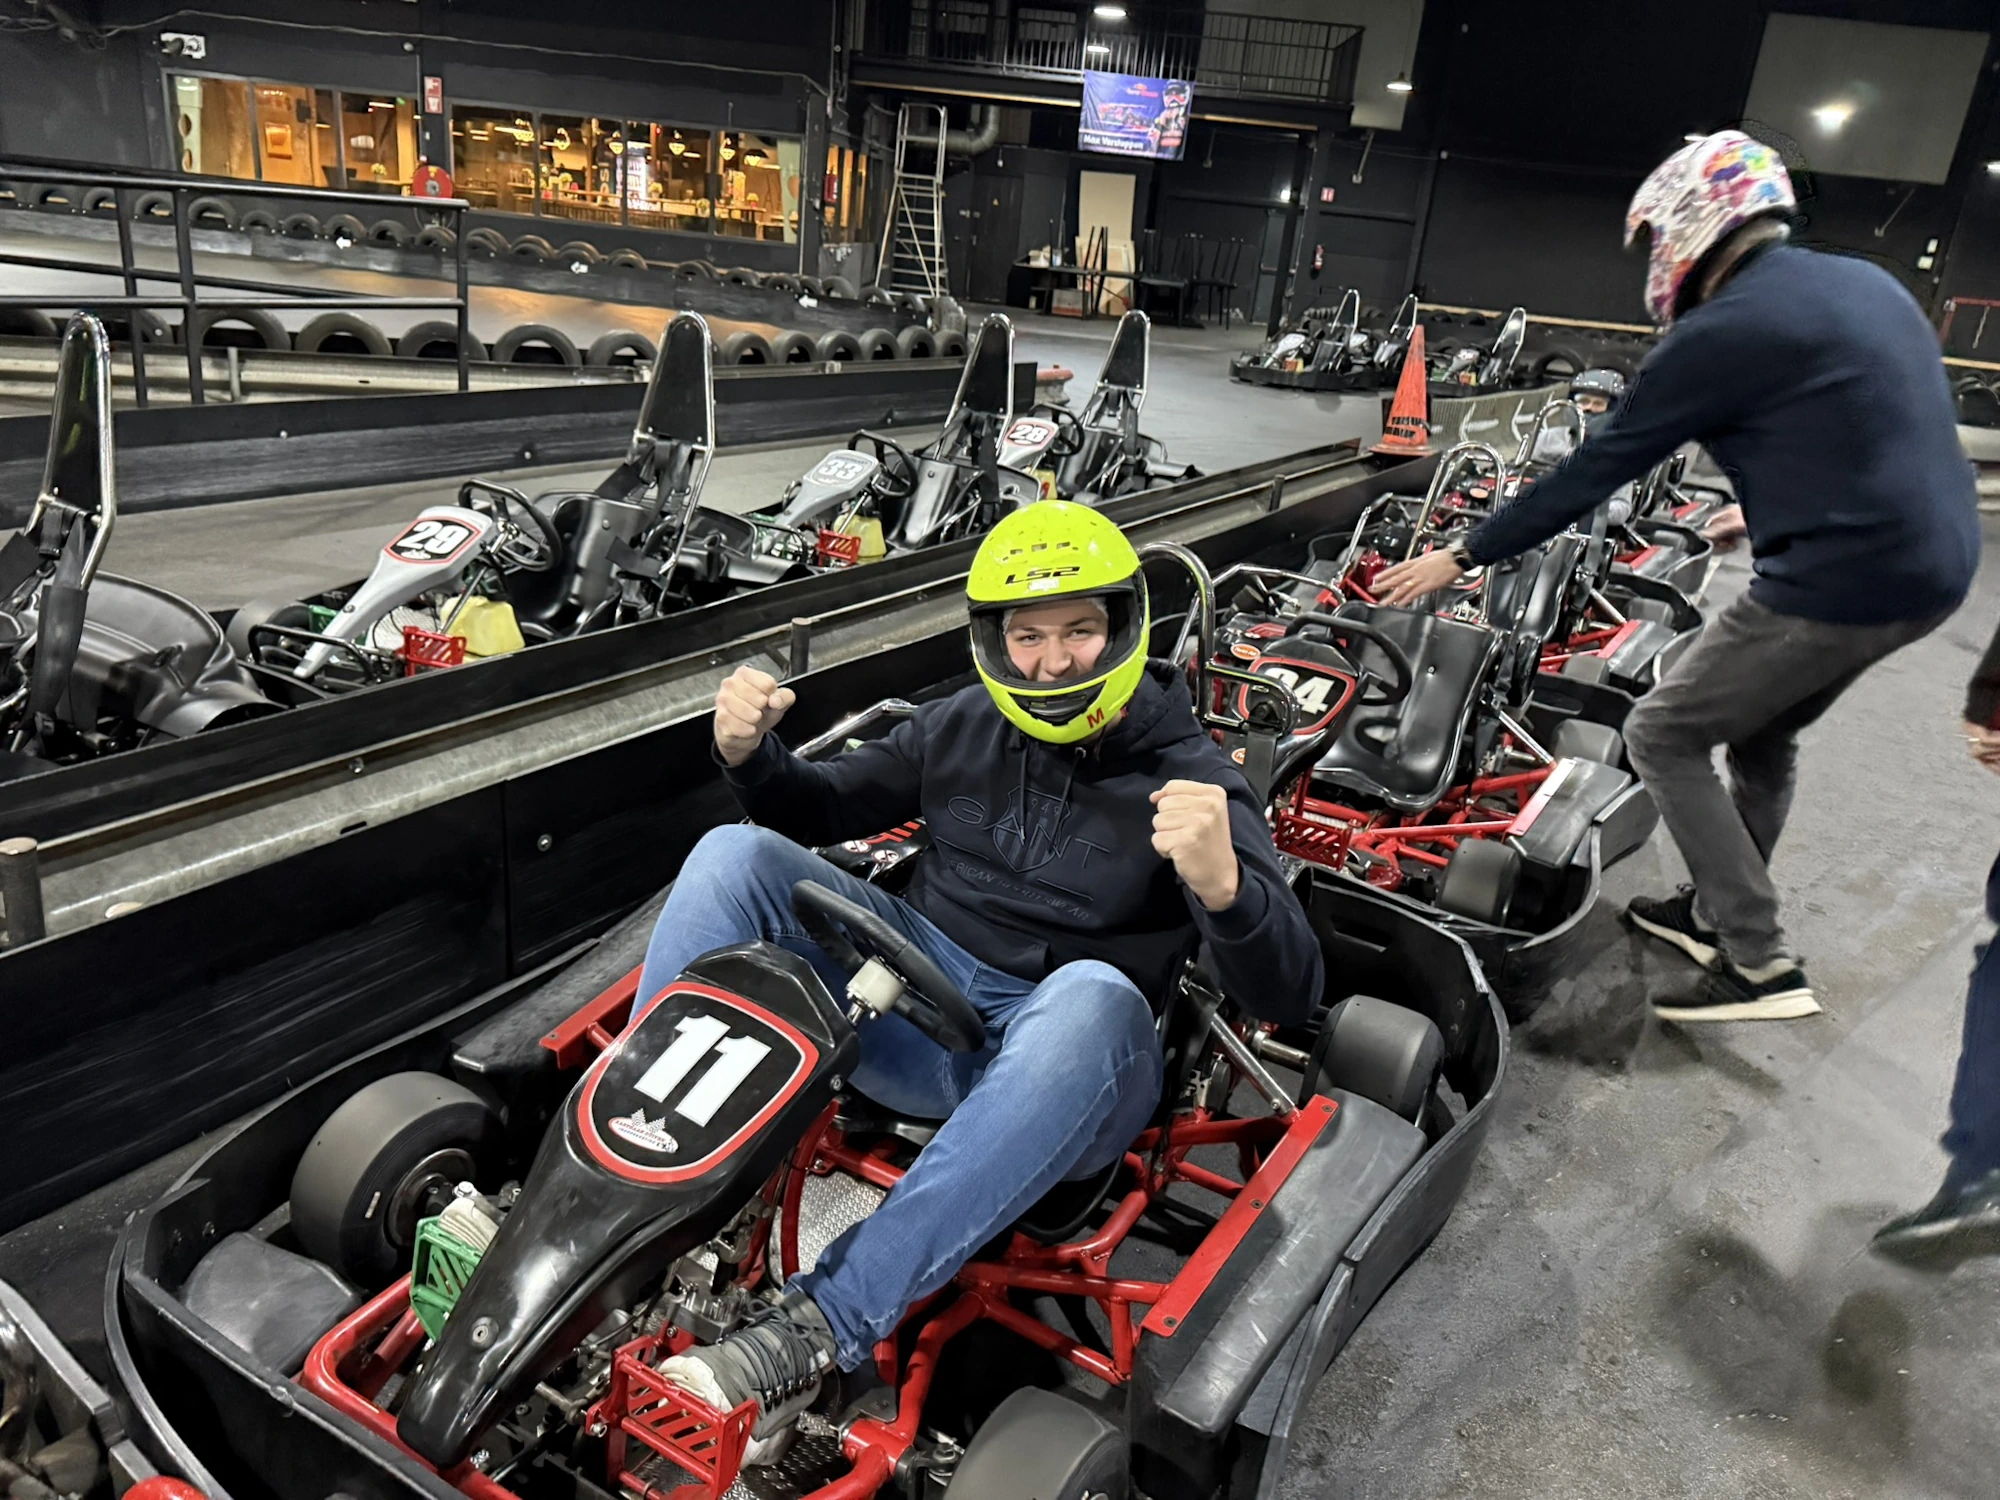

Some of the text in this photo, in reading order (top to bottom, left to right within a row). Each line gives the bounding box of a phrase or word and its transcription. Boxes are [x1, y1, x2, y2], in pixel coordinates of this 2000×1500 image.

[1083, 134, 1100, 144] Max
[1009, 424, 1049, 443] 28
[818, 459, 863, 480] 33
[396, 520, 470, 555] 29
[1004, 566, 1080, 585] LS2
[1086, 707, 1105, 729] M
[948, 796, 1110, 868] GANT
[633, 1014, 773, 1128] 11
